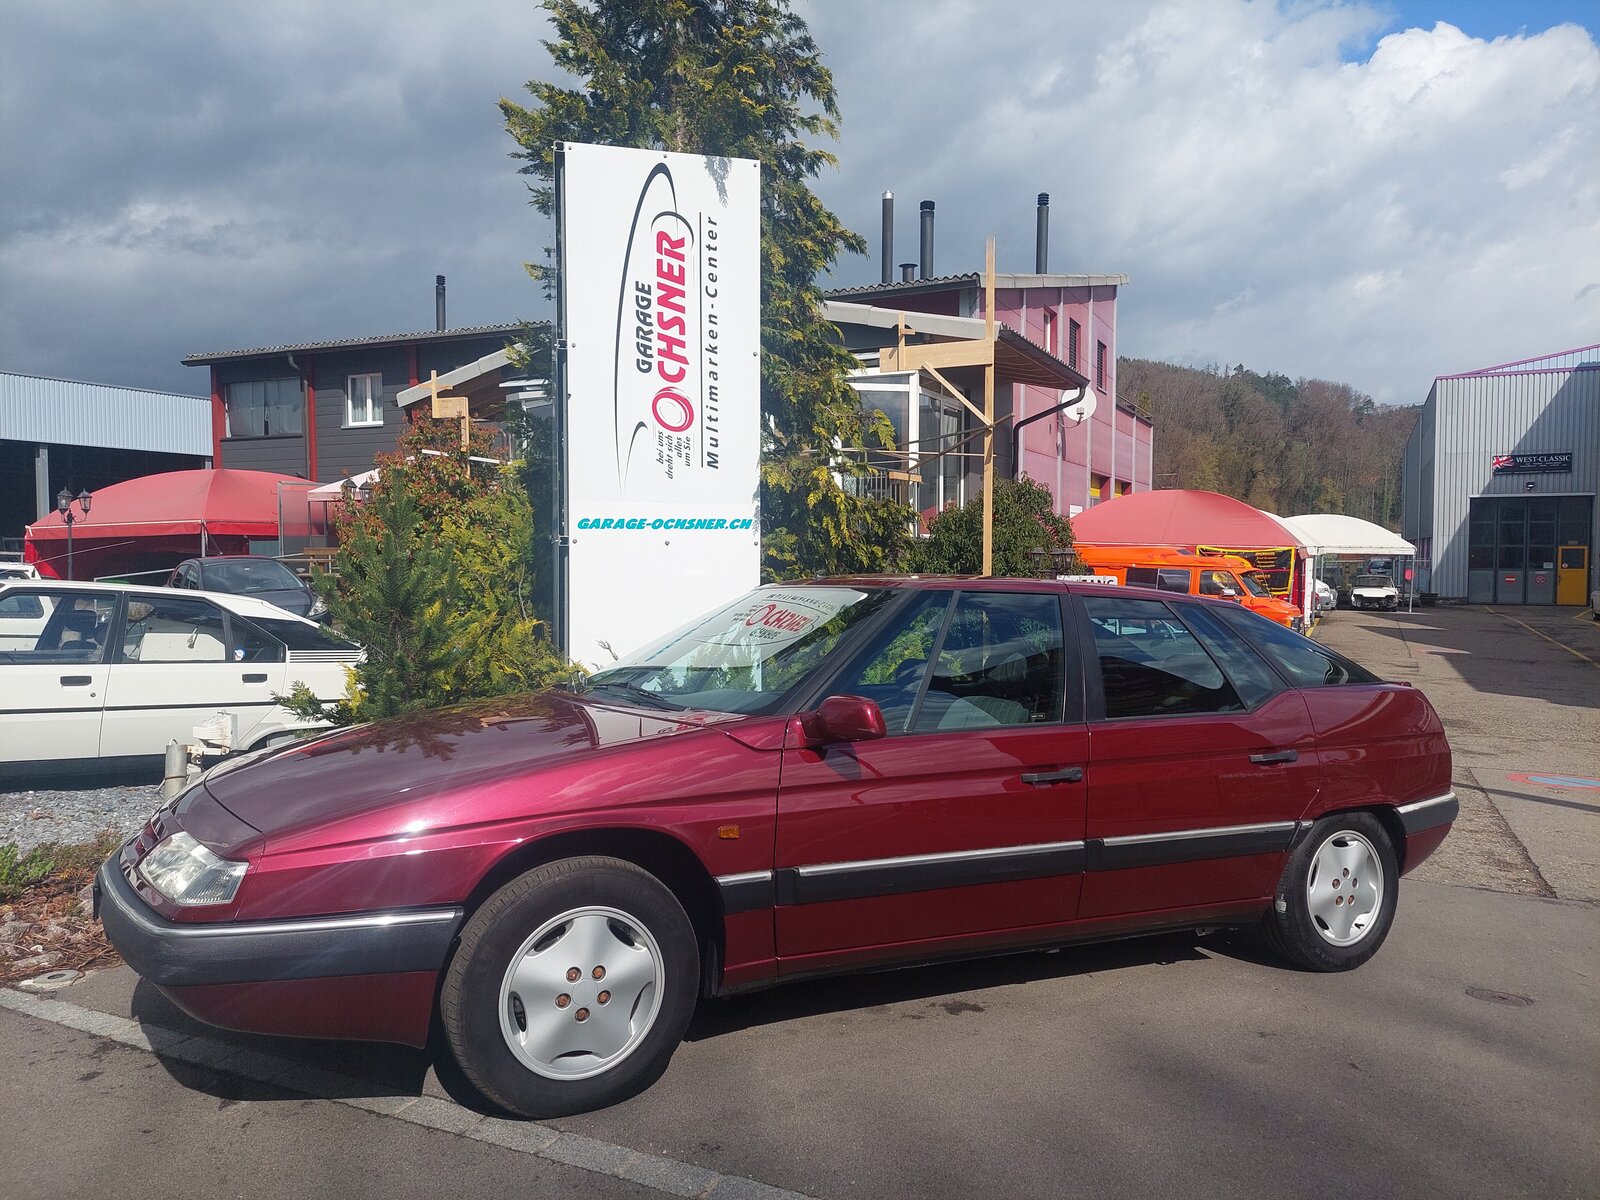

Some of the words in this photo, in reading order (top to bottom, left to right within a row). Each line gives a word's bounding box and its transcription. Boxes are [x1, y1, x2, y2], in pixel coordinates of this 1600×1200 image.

[635, 281, 654, 373] GARAGE
[652, 231, 694, 433] OCHSNER
[705, 216, 719, 469] Multimarken-Center
[665, 434, 673, 452] sich
[674, 436, 682, 458] alles
[683, 436, 691, 451] Sie
[656, 448, 664, 464] bei
[685, 452, 691, 467] um
[1515, 455, 1571, 463] WEST-CLASSIC
[665, 454, 673, 479] dreht
[577, 517, 753, 530] GARAGE-OCHSNER.CH
